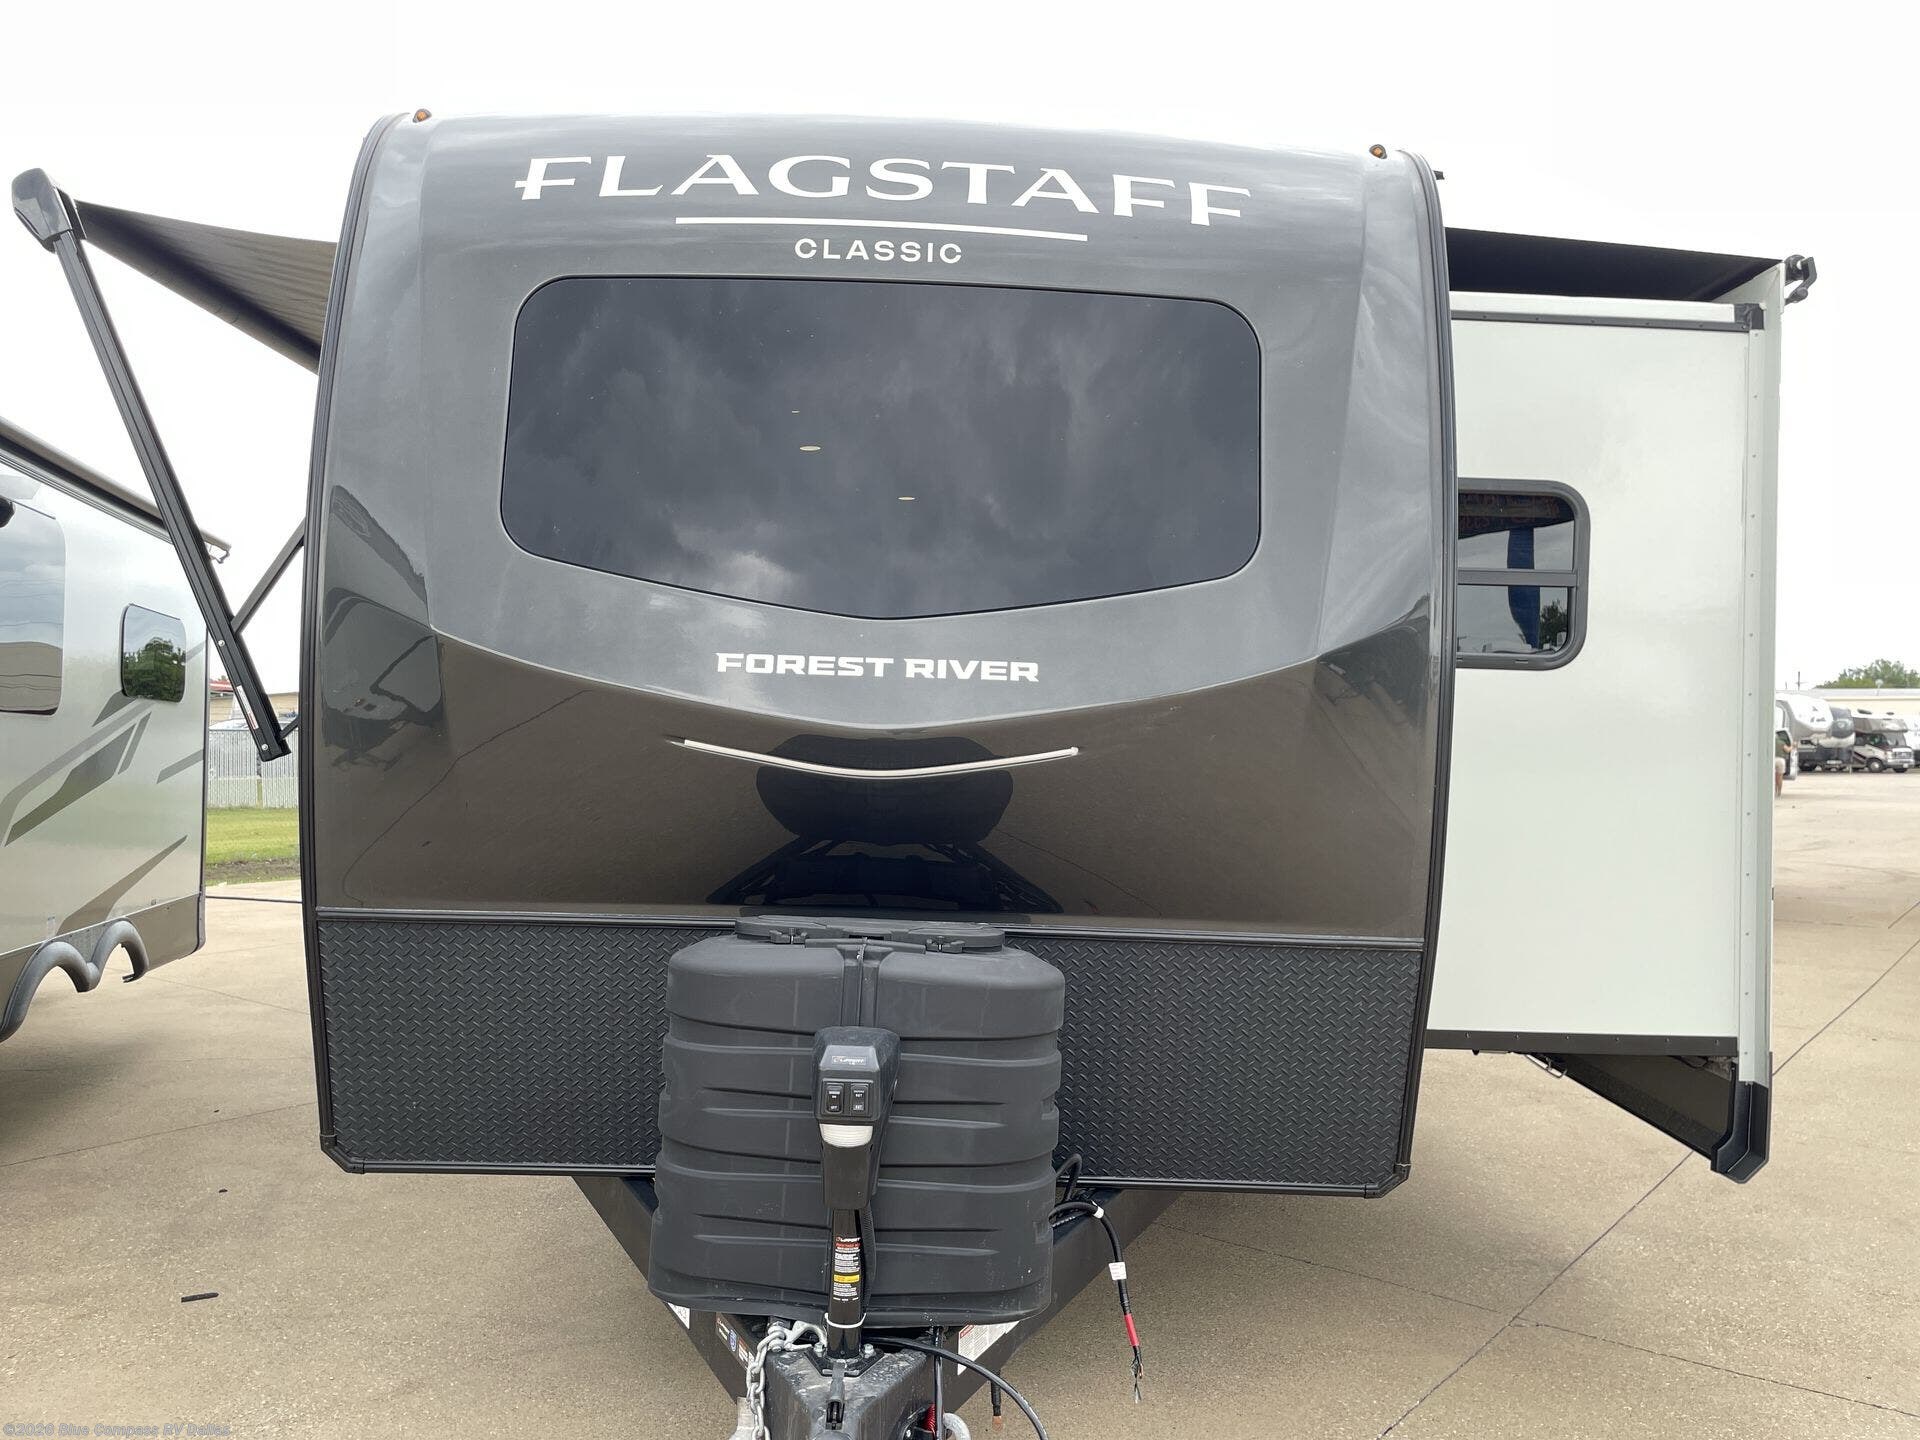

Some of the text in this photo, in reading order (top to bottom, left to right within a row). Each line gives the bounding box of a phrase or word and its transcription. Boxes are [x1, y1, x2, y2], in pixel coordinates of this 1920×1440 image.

[514, 153, 1252, 227] FLAGSTAFF
[794, 237, 964, 265] CLASSIC
[715, 651, 1040, 683] FOREST RIVER
